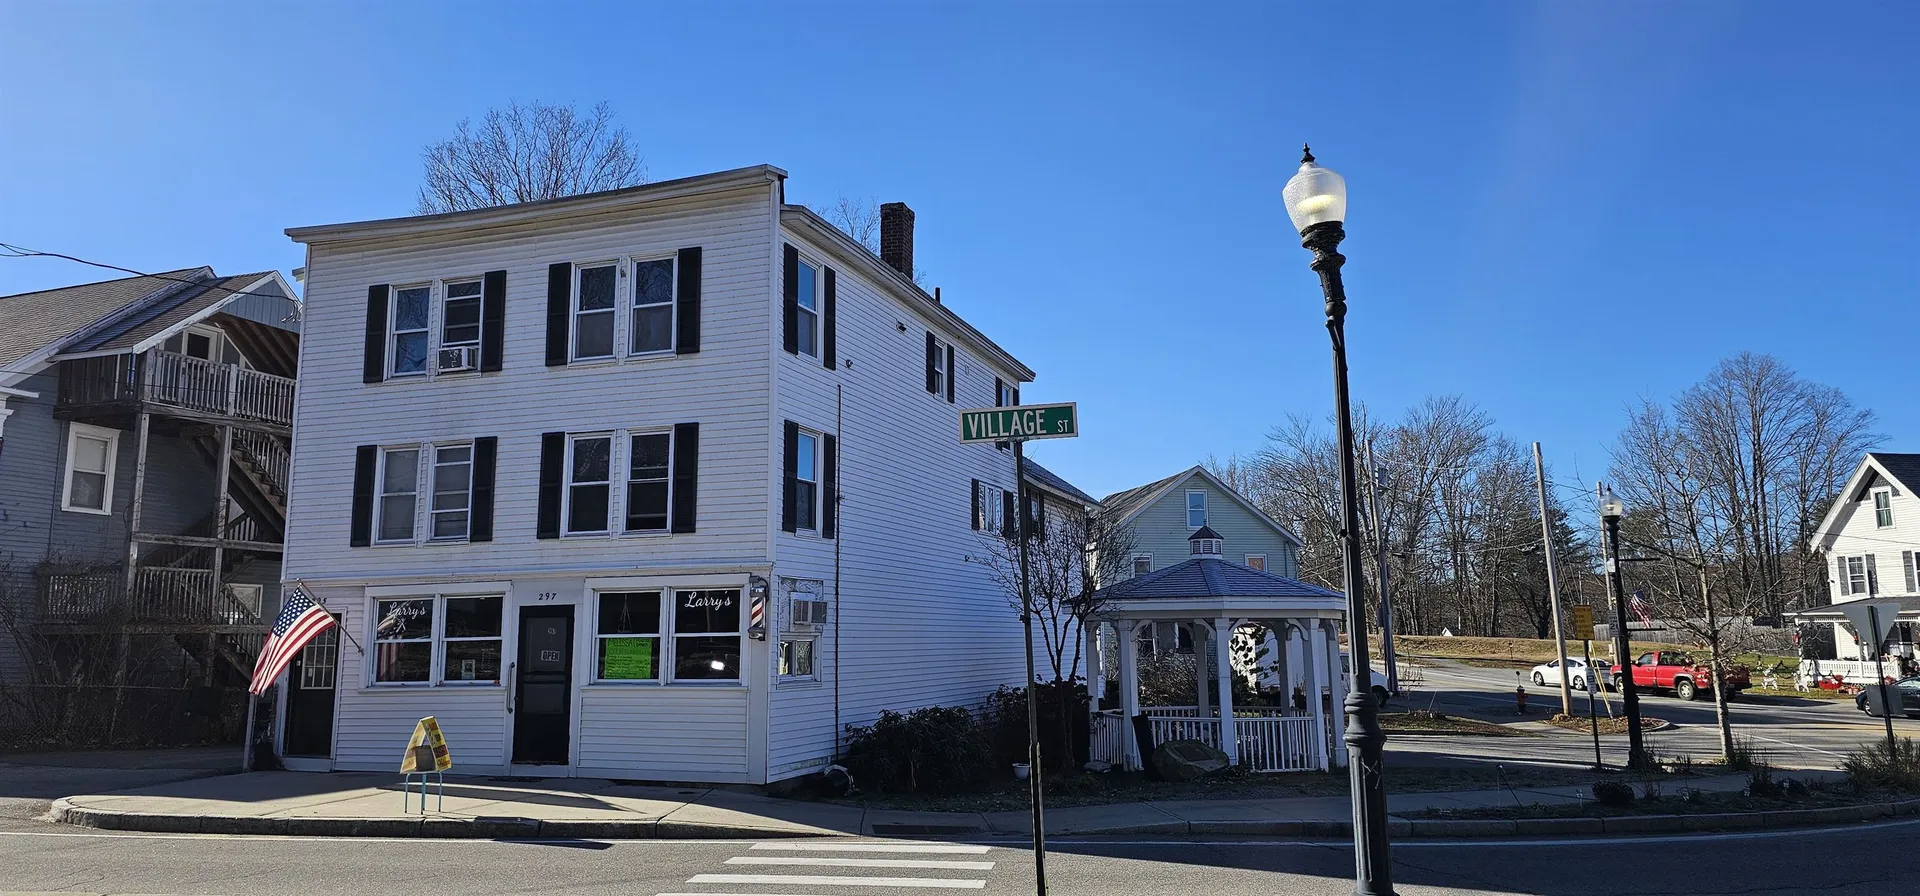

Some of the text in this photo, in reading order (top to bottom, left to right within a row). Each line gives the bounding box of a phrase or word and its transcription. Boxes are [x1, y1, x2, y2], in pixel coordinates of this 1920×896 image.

[968, 410, 1069, 438] VILLAGE ST
[538, 592, 557, 601] 297
[684, 590, 732, 611] Larry's
[386, 601, 427, 620] Larry's
[542, 650, 559, 661] OPEN
